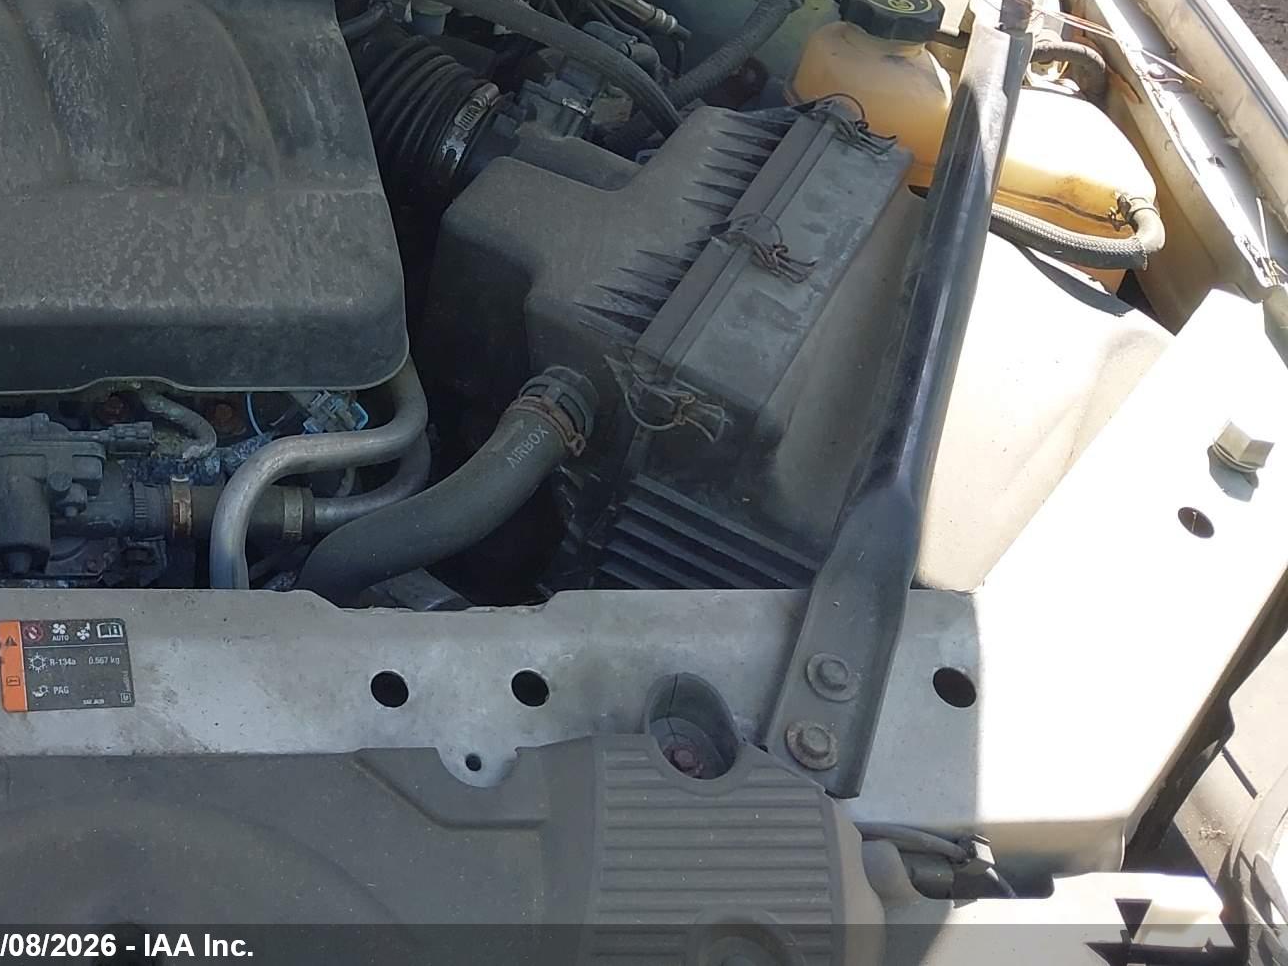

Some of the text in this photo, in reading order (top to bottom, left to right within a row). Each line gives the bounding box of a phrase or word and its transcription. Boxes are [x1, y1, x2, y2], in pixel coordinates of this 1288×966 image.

[506, 424, 549, 468] AIRBOX
[49, 658, 76, 666] R-134a
[53, 686, 69, 695] PAG
